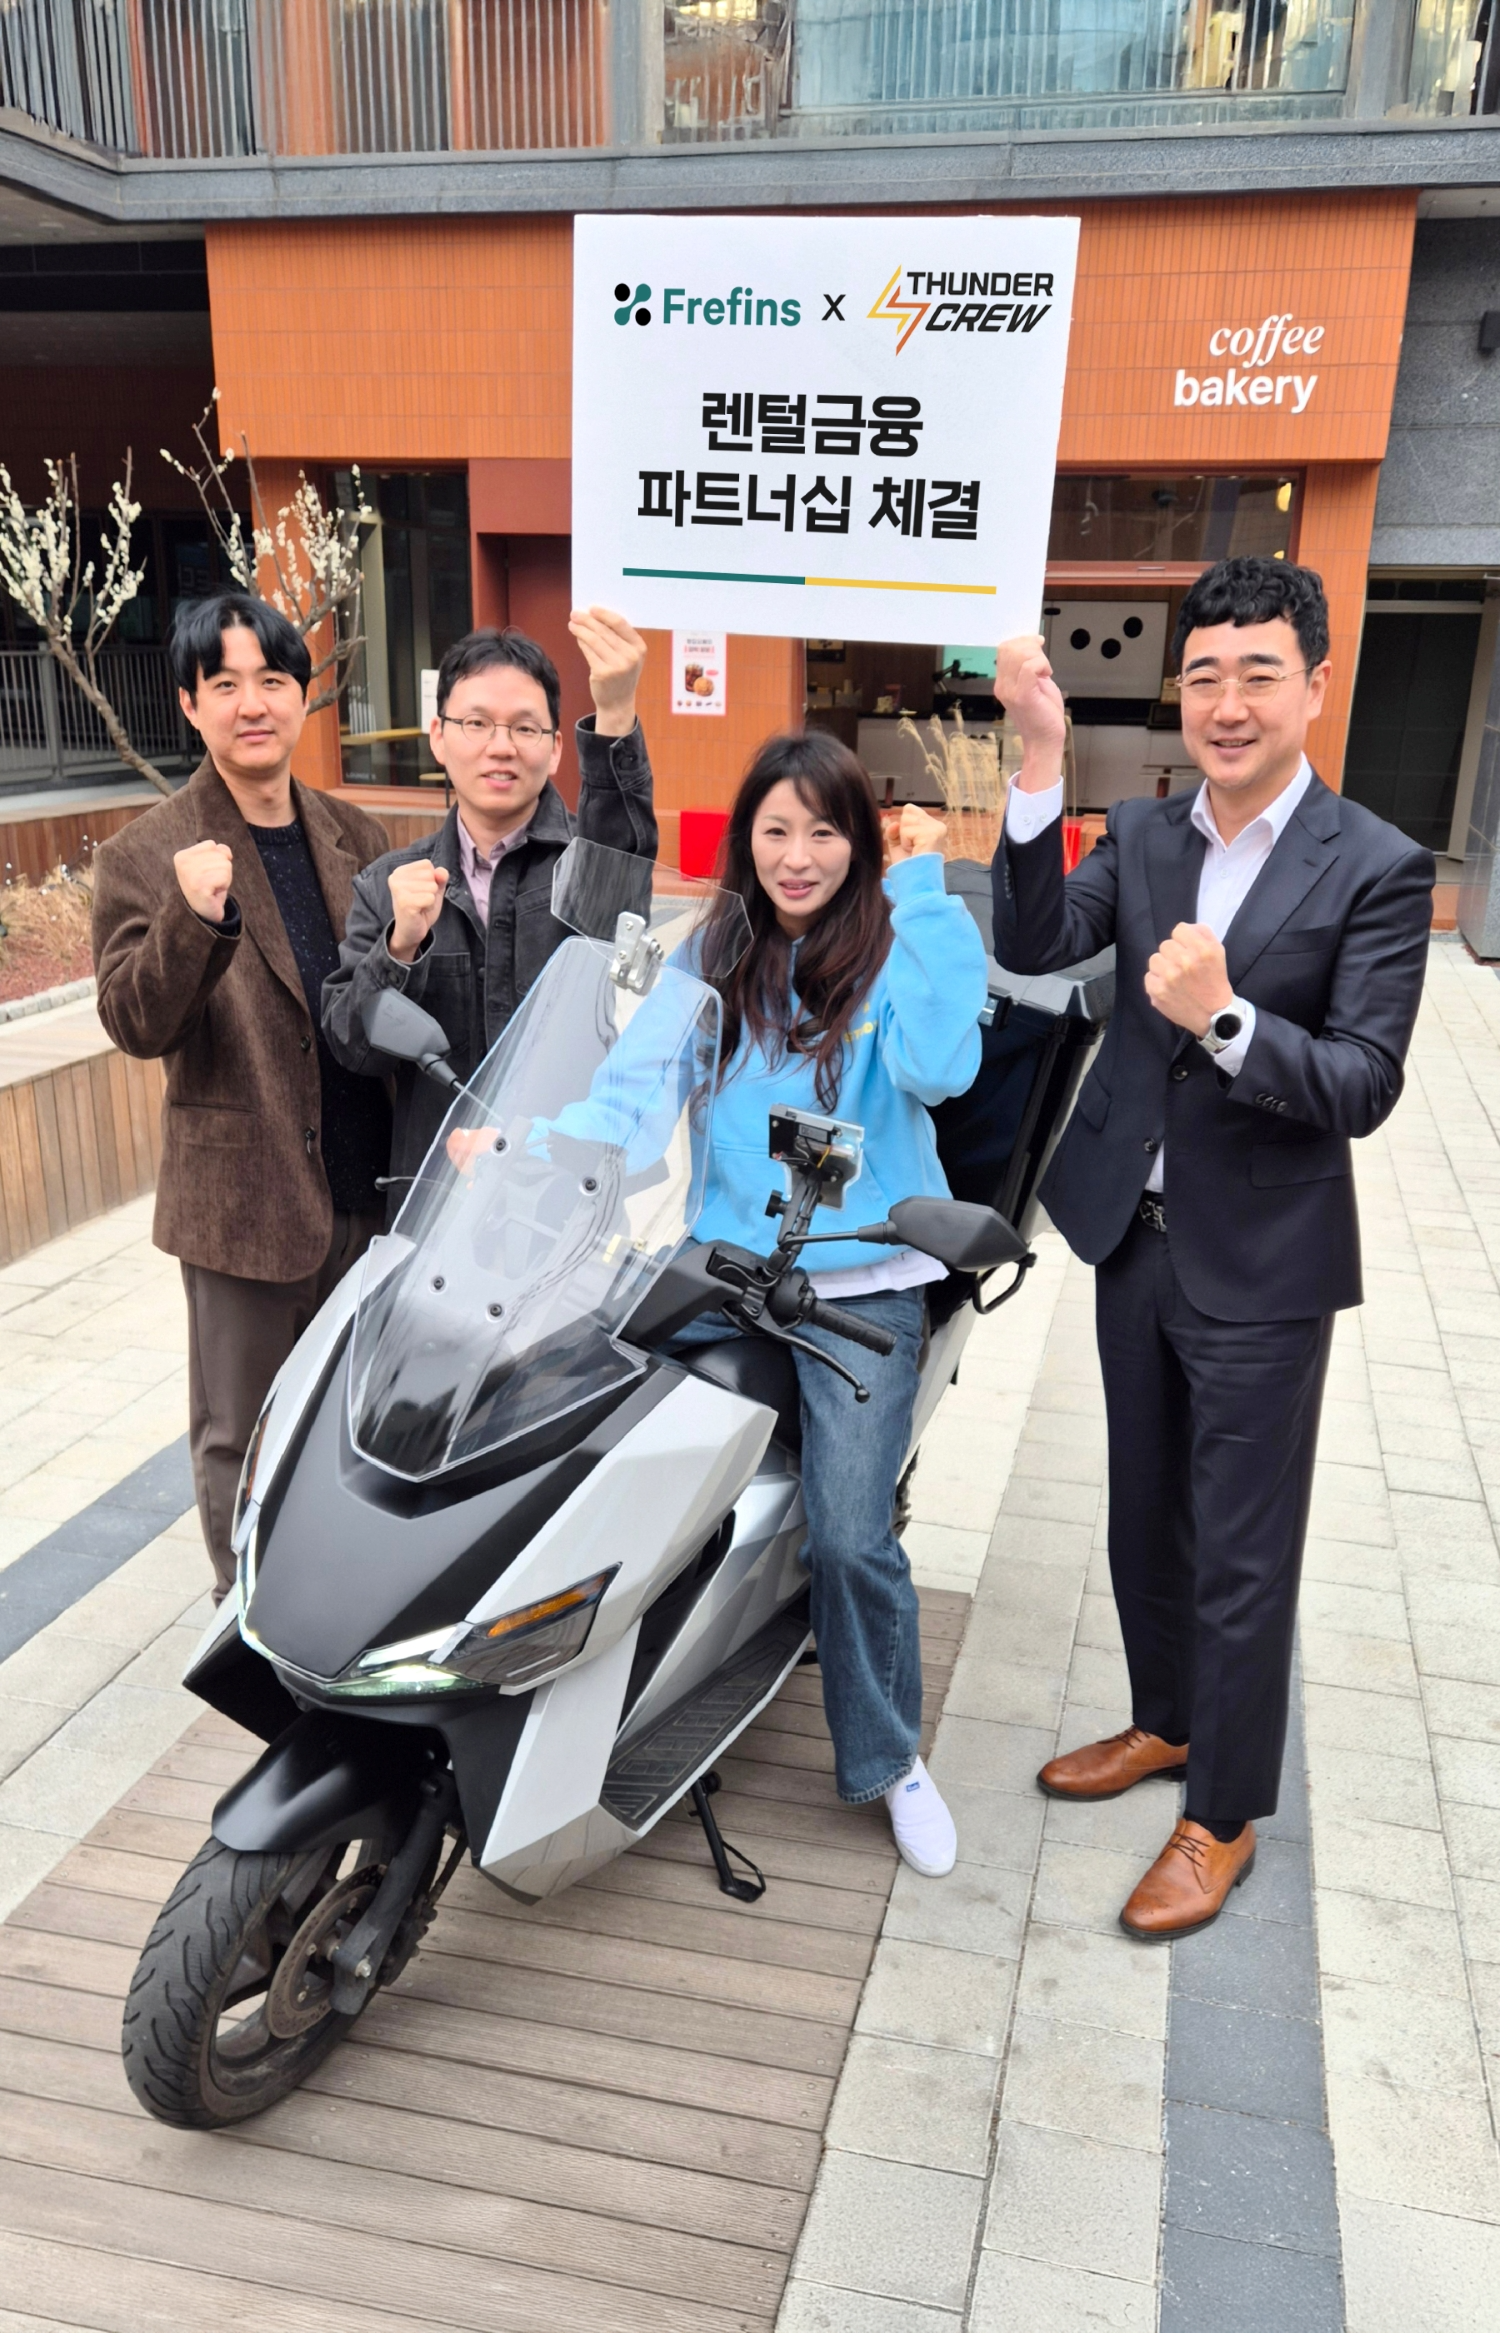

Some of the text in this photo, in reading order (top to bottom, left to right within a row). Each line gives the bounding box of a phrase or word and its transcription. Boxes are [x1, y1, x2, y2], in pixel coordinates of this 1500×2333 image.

[663, 286, 801, 327] Frefins
[906, 271, 1054, 297] THUNDER
[925, 302, 1052, 333] CREW
[1209, 313, 1326, 369] coffee
[1173, 367, 1319, 414] bakery
[701, 392, 924, 458] 렌털금융
[637, 469, 981, 541] 파트너십 체결
